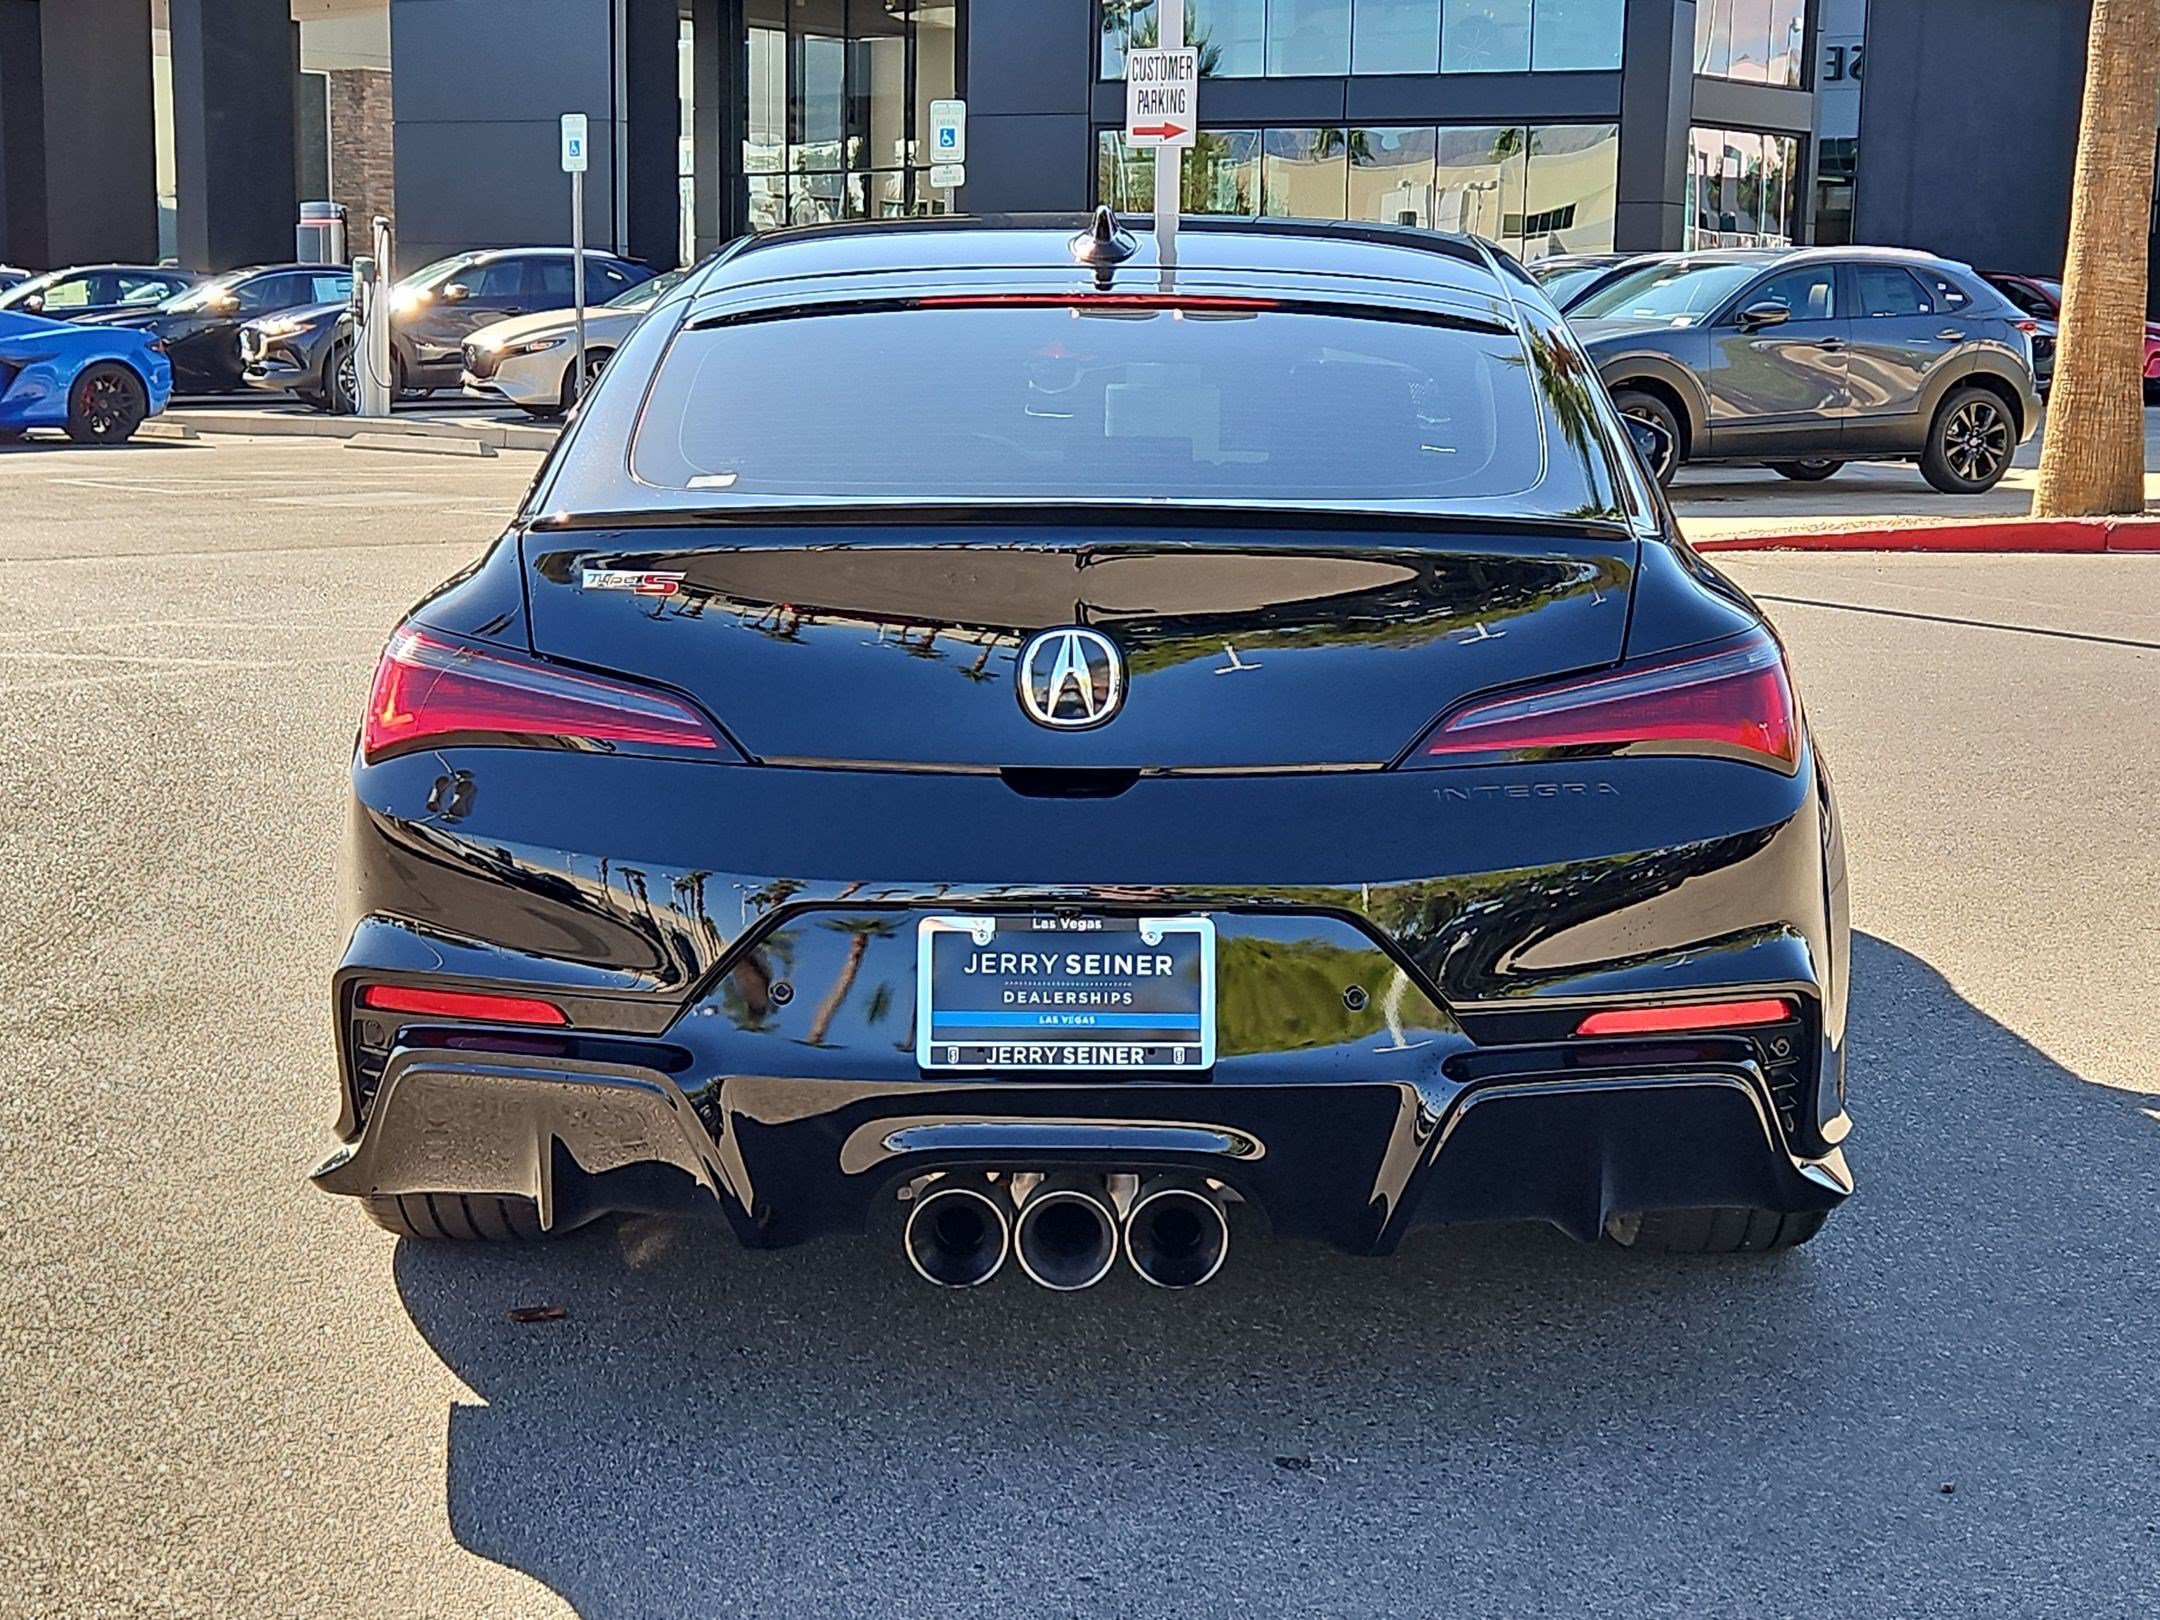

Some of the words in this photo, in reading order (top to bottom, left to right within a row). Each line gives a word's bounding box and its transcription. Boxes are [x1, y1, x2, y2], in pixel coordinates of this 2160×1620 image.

[1132, 55, 1193, 82] CUSTOMER
[1137, 88, 1186, 115] PARKING
[1433, 782, 1621, 801] INTEGRA
[1032, 918, 1056, 930] Las
[1060, 918, 1103, 932] Vegas
[963, 953, 1059, 975] JERRY
[1065, 954, 1174, 976] SEINER
[1003, 991, 1133, 1005] DEALERSHIPS
[1039, 1015, 1059, 1025] LAS
[1062, 1015, 1096, 1025] VEGAS
[986, 1047, 1058, 1064] JERRY
[1063, 1047, 1145, 1065] SEINER
